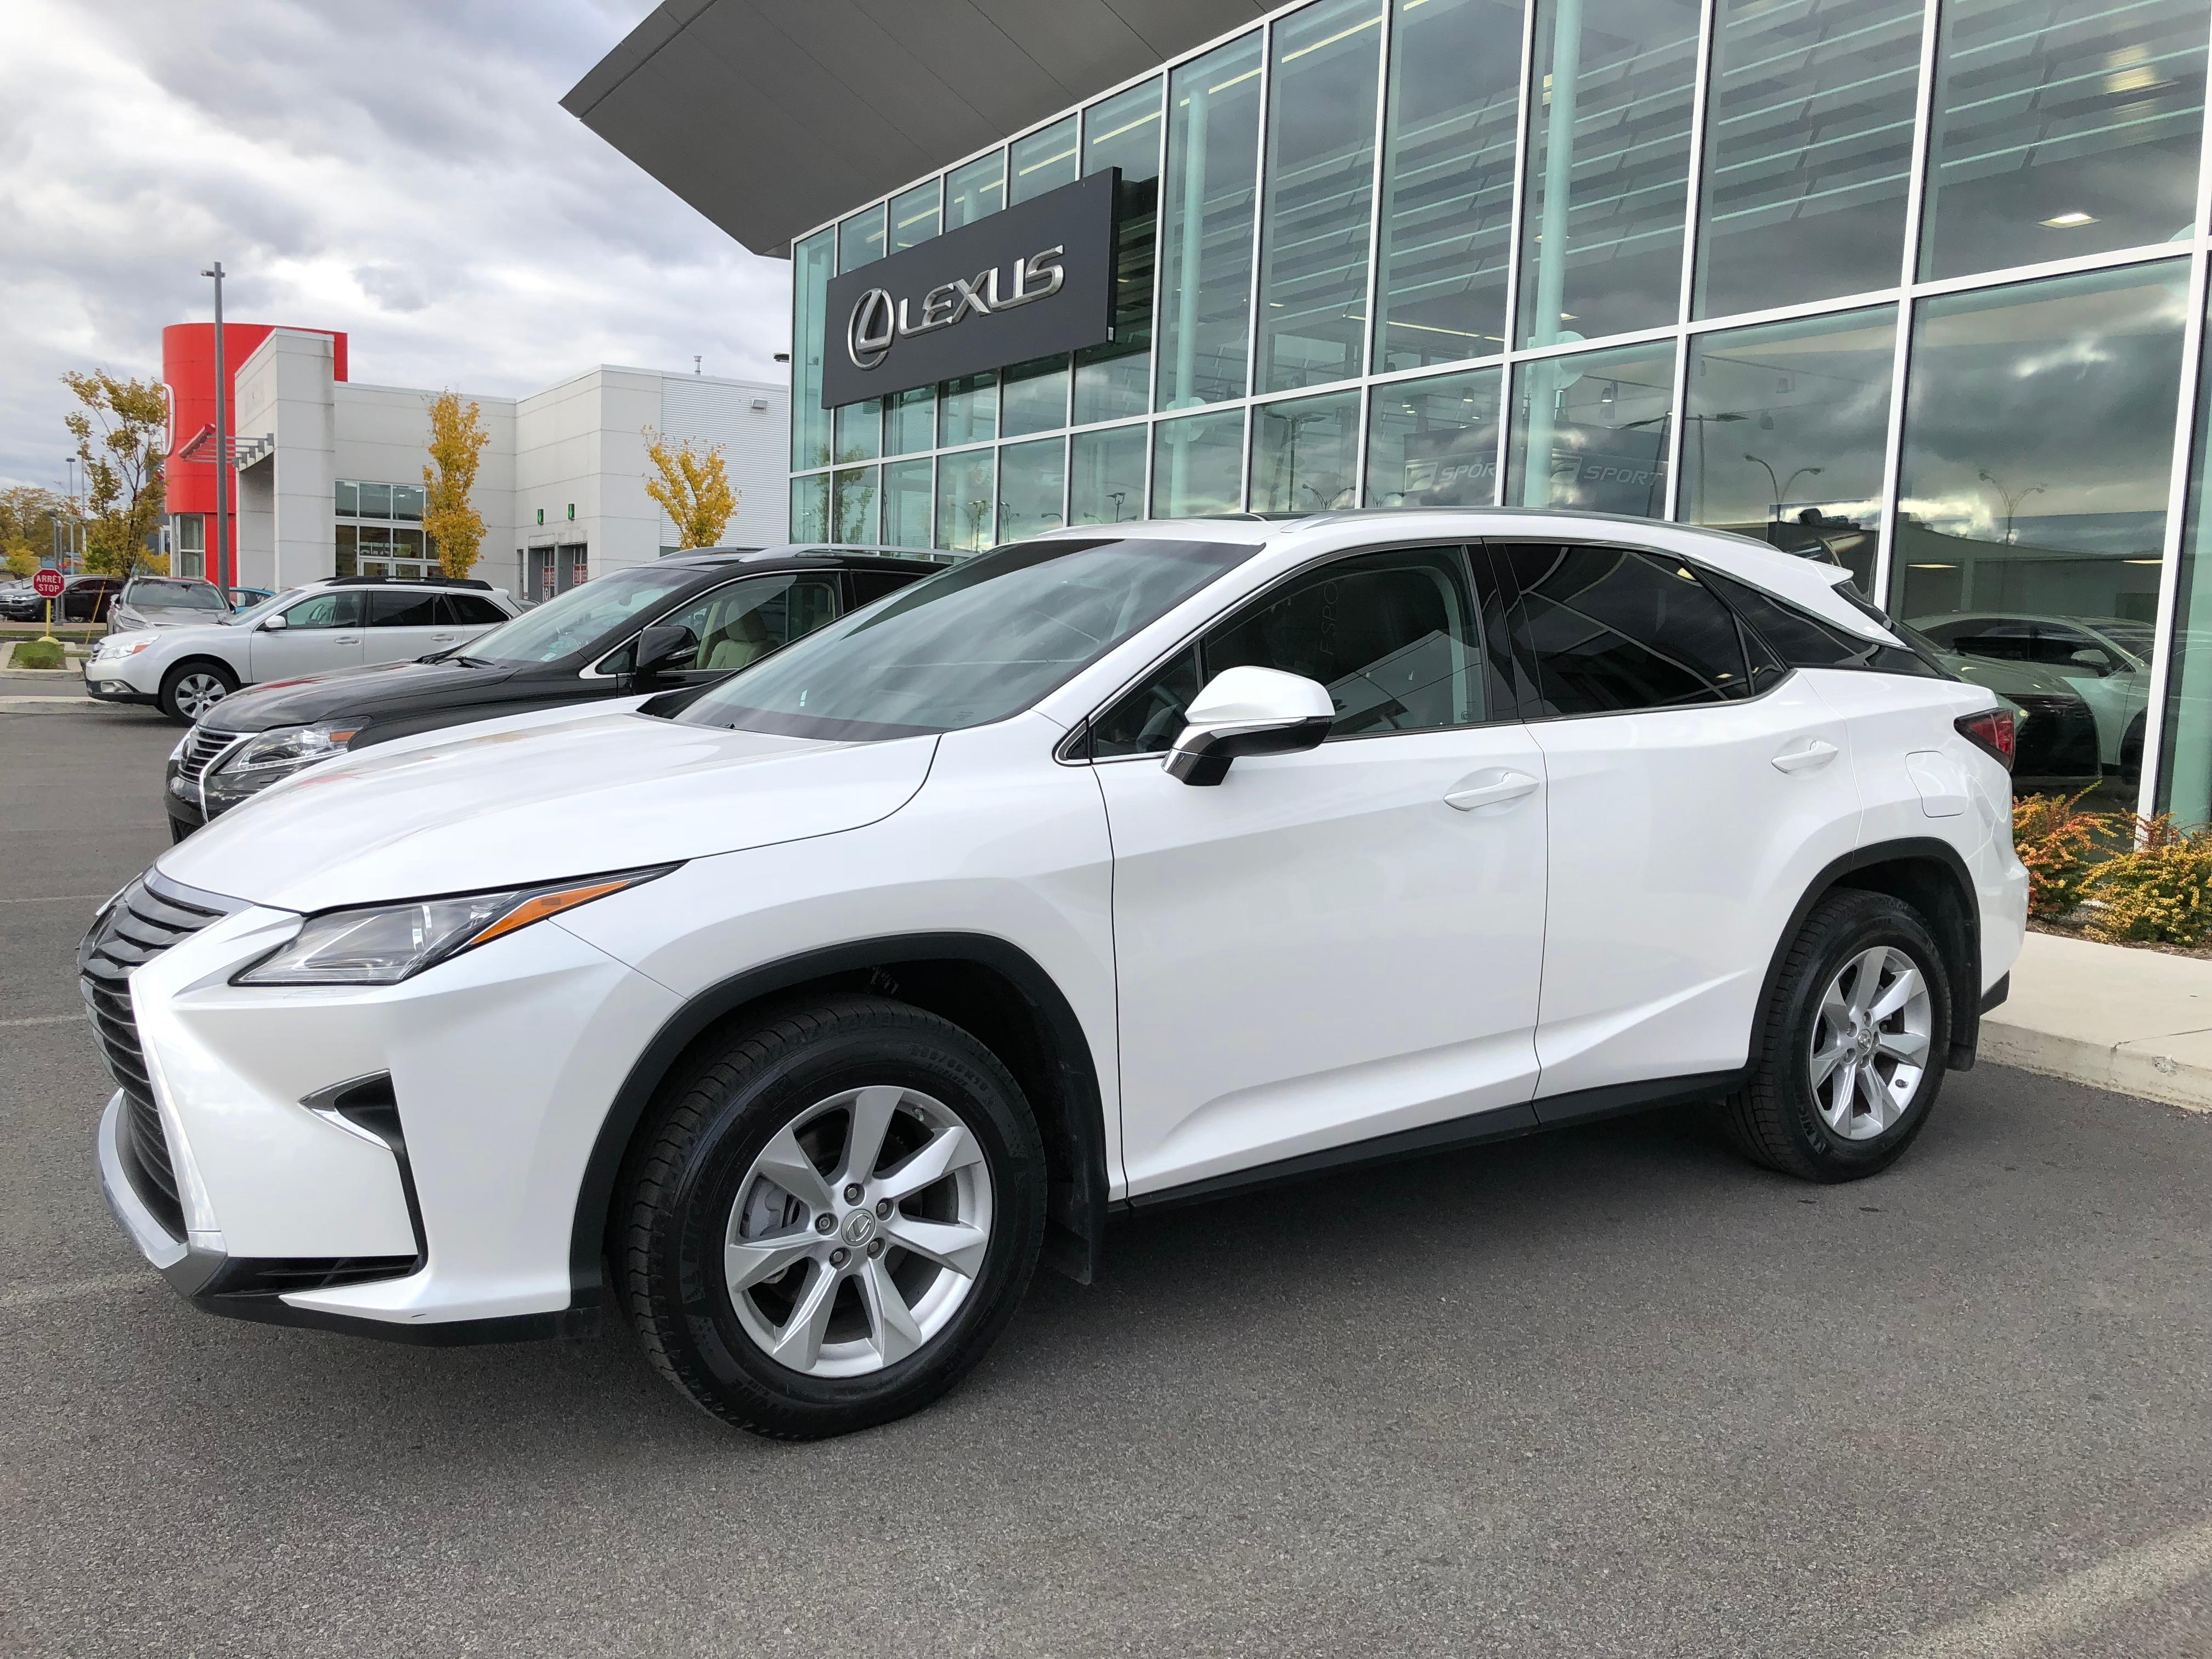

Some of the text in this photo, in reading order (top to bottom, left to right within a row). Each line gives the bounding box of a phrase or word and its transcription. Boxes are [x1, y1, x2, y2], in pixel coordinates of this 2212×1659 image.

[899, 245, 1065, 337] LEXUS
[1439, 462, 1497, 483] SPOR
[1583, 466, 1663, 486] SPORT
[37, 575, 61, 584] ARRÊT
